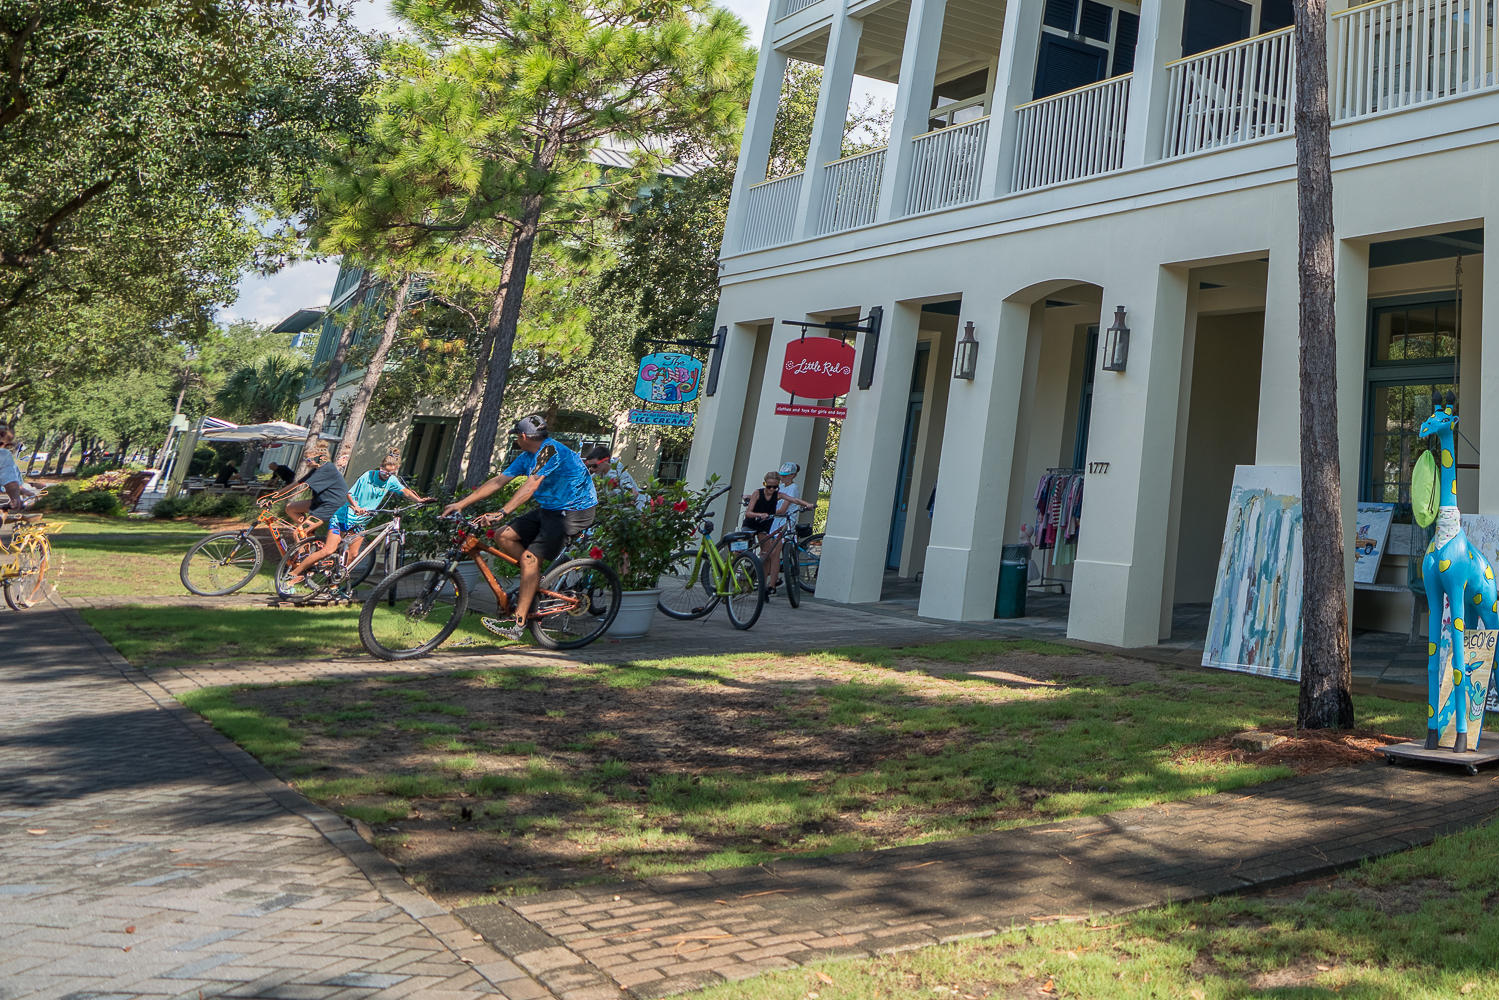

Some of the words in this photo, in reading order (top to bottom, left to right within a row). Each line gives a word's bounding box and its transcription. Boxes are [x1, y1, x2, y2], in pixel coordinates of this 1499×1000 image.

[662, 355, 685, 366] The
[794, 358, 821, 374] Little
[821, 361, 841, 376] Red
[653, 416, 686, 424] CREAM
[1089, 461, 1110, 474] 1777
